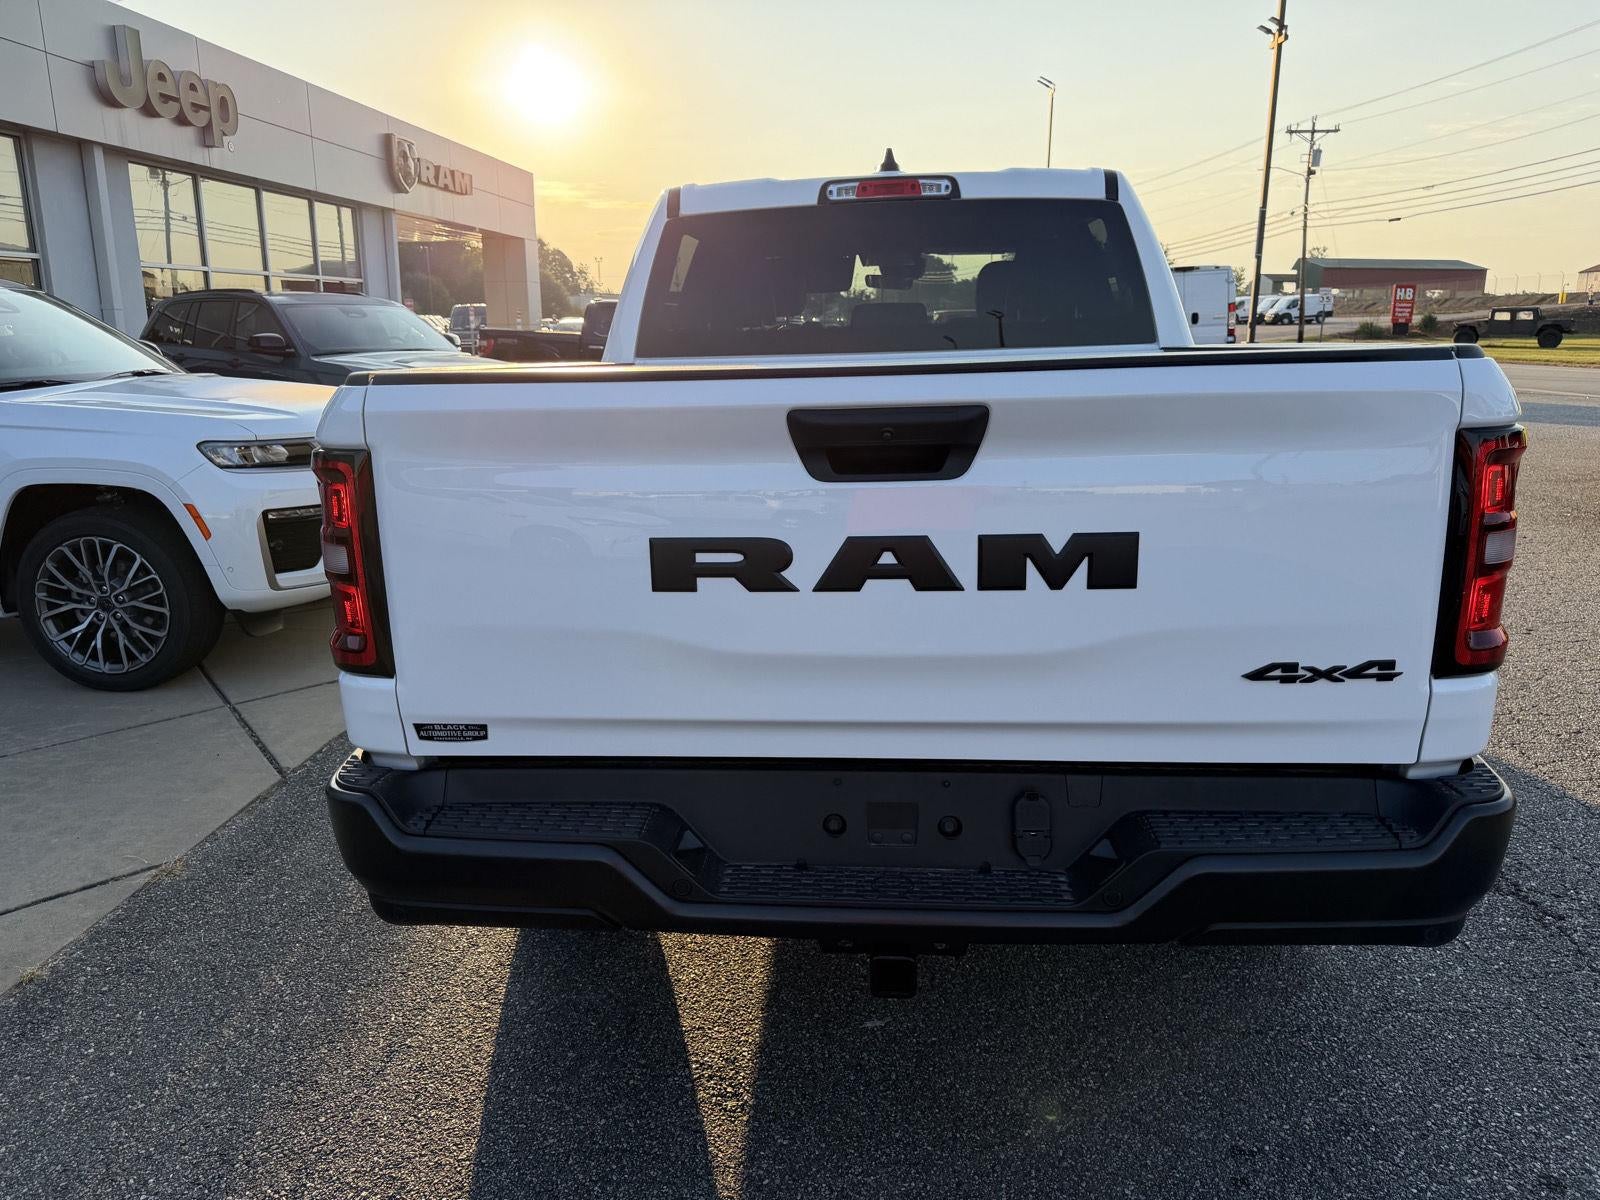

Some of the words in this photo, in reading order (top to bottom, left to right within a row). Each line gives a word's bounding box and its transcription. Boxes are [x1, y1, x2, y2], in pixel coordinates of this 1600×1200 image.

[94, 25, 238, 148] Jeep
[418, 158, 473, 196] RAM
[649, 531, 1139, 592] RAM
[1241, 659, 1404, 684] 4x4
